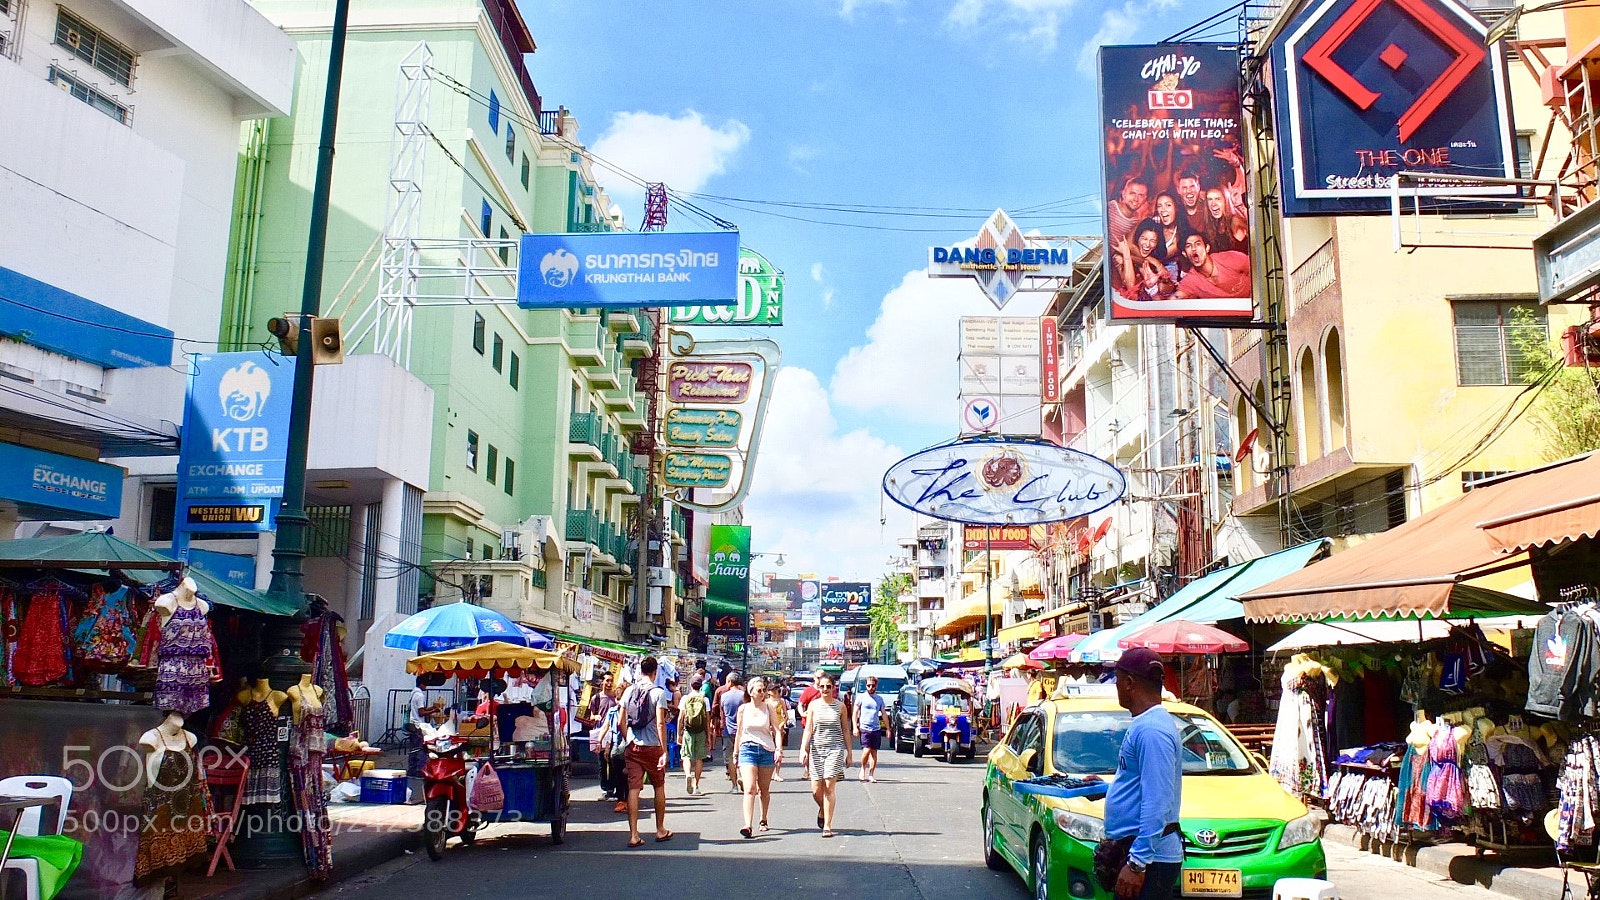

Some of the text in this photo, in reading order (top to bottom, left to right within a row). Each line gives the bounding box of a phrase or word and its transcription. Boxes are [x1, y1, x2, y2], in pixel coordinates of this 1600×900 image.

[1150, 92, 1190, 107] LEO
[1178, 119, 1201, 128] LIKE
[1173, 129, 1198, 139] WITH
[1355, 147, 1450, 167] THE ONE
[1325, 173, 1374, 190] Street
[585, 248, 719, 271] ธนาคารกรุงไทย
[933, 247, 1068, 265] DANG DERM
[960, 263, 998, 271] Authentic
[1001, 263, 1018, 271] Thai
[585, 272, 691, 284] KRUNGTHAI BANK
[765, 275, 779, 319] INN
[1046, 326, 1055, 398] INDIAN FOOD
[212, 427, 269, 452] KTB
[189, 463, 264, 476] EXCHANGE
[33, 468, 107, 495] EXCHANGE
[911, 458, 1109, 506] The Club
[187, 485, 208, 495] ATM
[223, 485, 245, 494] ADM
[190, 506, 262, 522] WESTERN WU
[202, 514, 231, 522] UNION
[965, 528, 1028, 541] INDIAN FOOD
[709, 562, 748, 579] Chang
[1210, 872, 1237, 885] 7744
